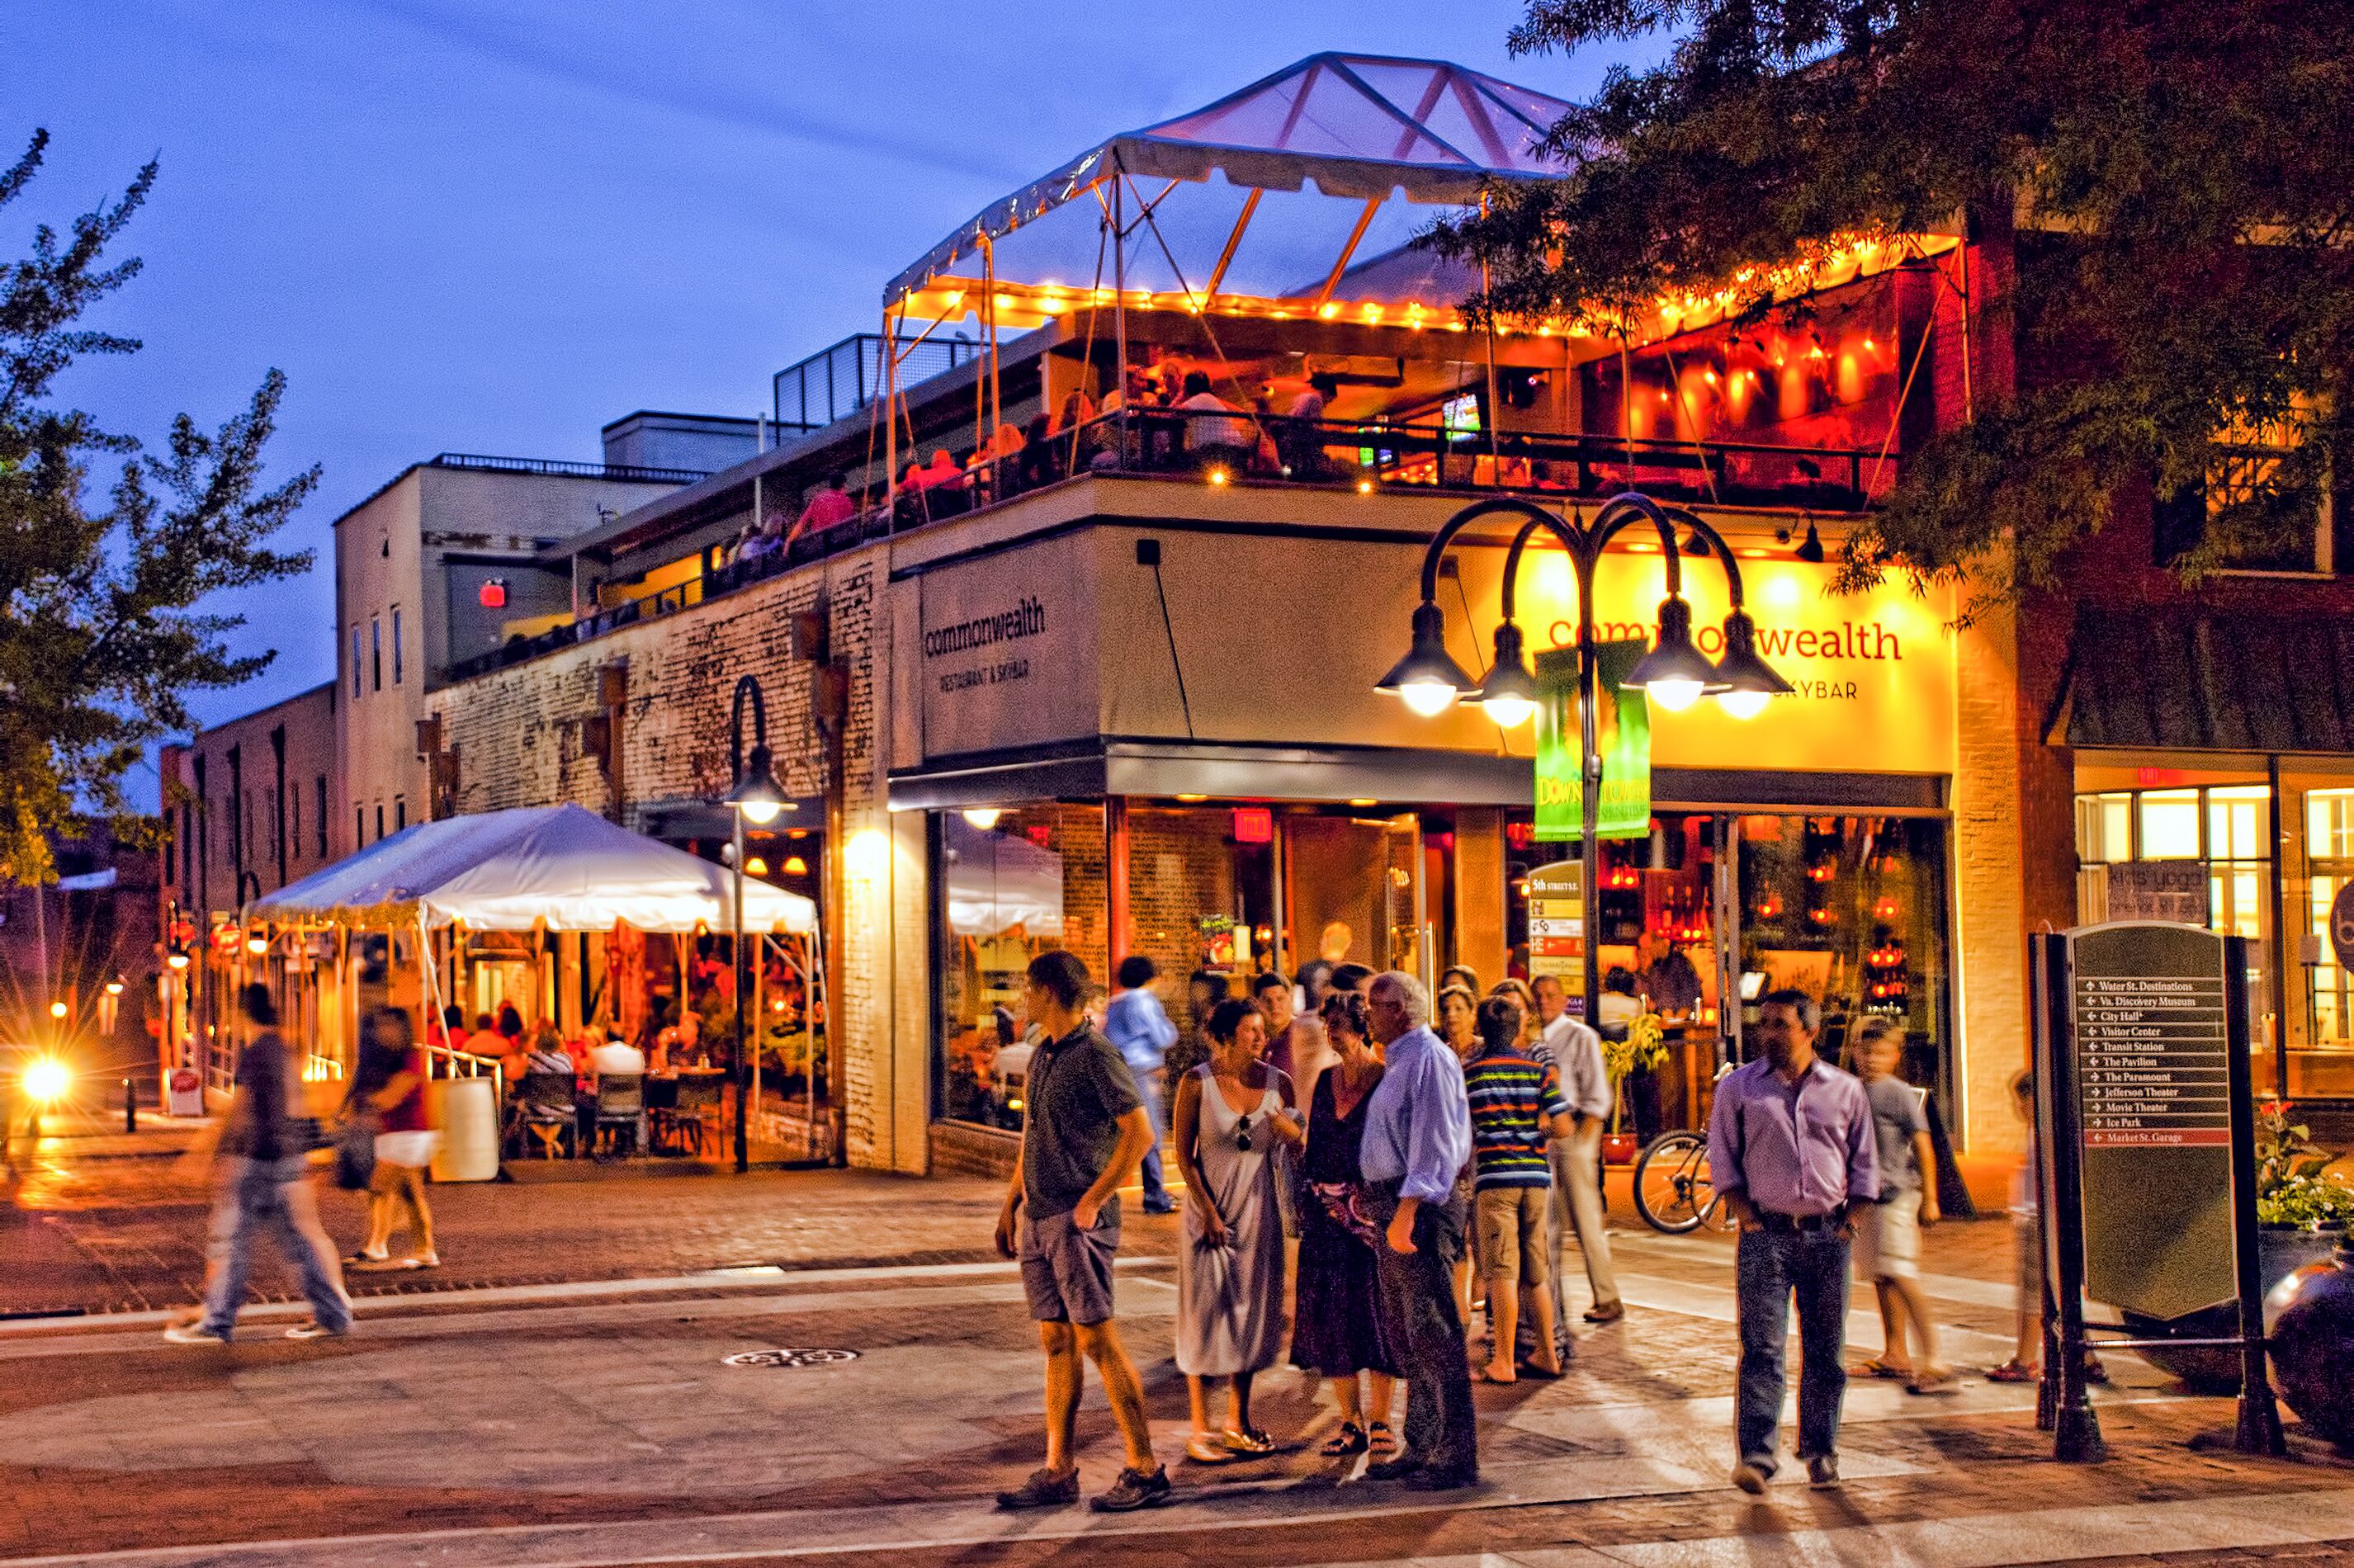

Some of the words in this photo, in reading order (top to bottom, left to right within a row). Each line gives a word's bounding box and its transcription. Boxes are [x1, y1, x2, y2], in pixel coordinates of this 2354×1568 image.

[925, 595, 1046, 658] commonwealth
[1773, 679, 1858, 700] KYBAR
[1533, 878, 1546, 891] 5th
[2099, 980, 2125, 991] Water
[2126, 980, 2139, 991] St.
[2139, 980, 2193, 991] Destinations
[2100, 995, 2114, 1006] Va.
[2115, 995, 2158, 1008] Discovery
[2158, 996, 2196, 1007] Museum
[2100, 1011, 2119, 1023] City
[2101, 1026, 2129, 1037] Visitor
[2131, 1027, 2161, 1037] Center
[2102, 1041, 2132, 1052] Transit
[2134, 1041, 2164, 1052] Station
[2103, 1056, 2121, 1067] The
[2122, 1056, 2158, 1067] Pavilion
[2105, 1072, 2123, 1082] The
[2124, 1072, 2172, 1083] Paramount
[2105, 1087, 2144, 1098] Jefferson
[2145, 1087, 2179, 1098] Theater
[2106, 1102, 2133, 1112] Movie
[2134, 1102, 2168, 1112] Theater
[2106, 1117, 2120, 1128] Ice
[2121, 1117, 2142, 1128] Park
[2107, 1132, 2138, 1143] Market
[2139, 1132, 2150, 1143] St.
[2152, 1132, 2183, 1145] Garage
